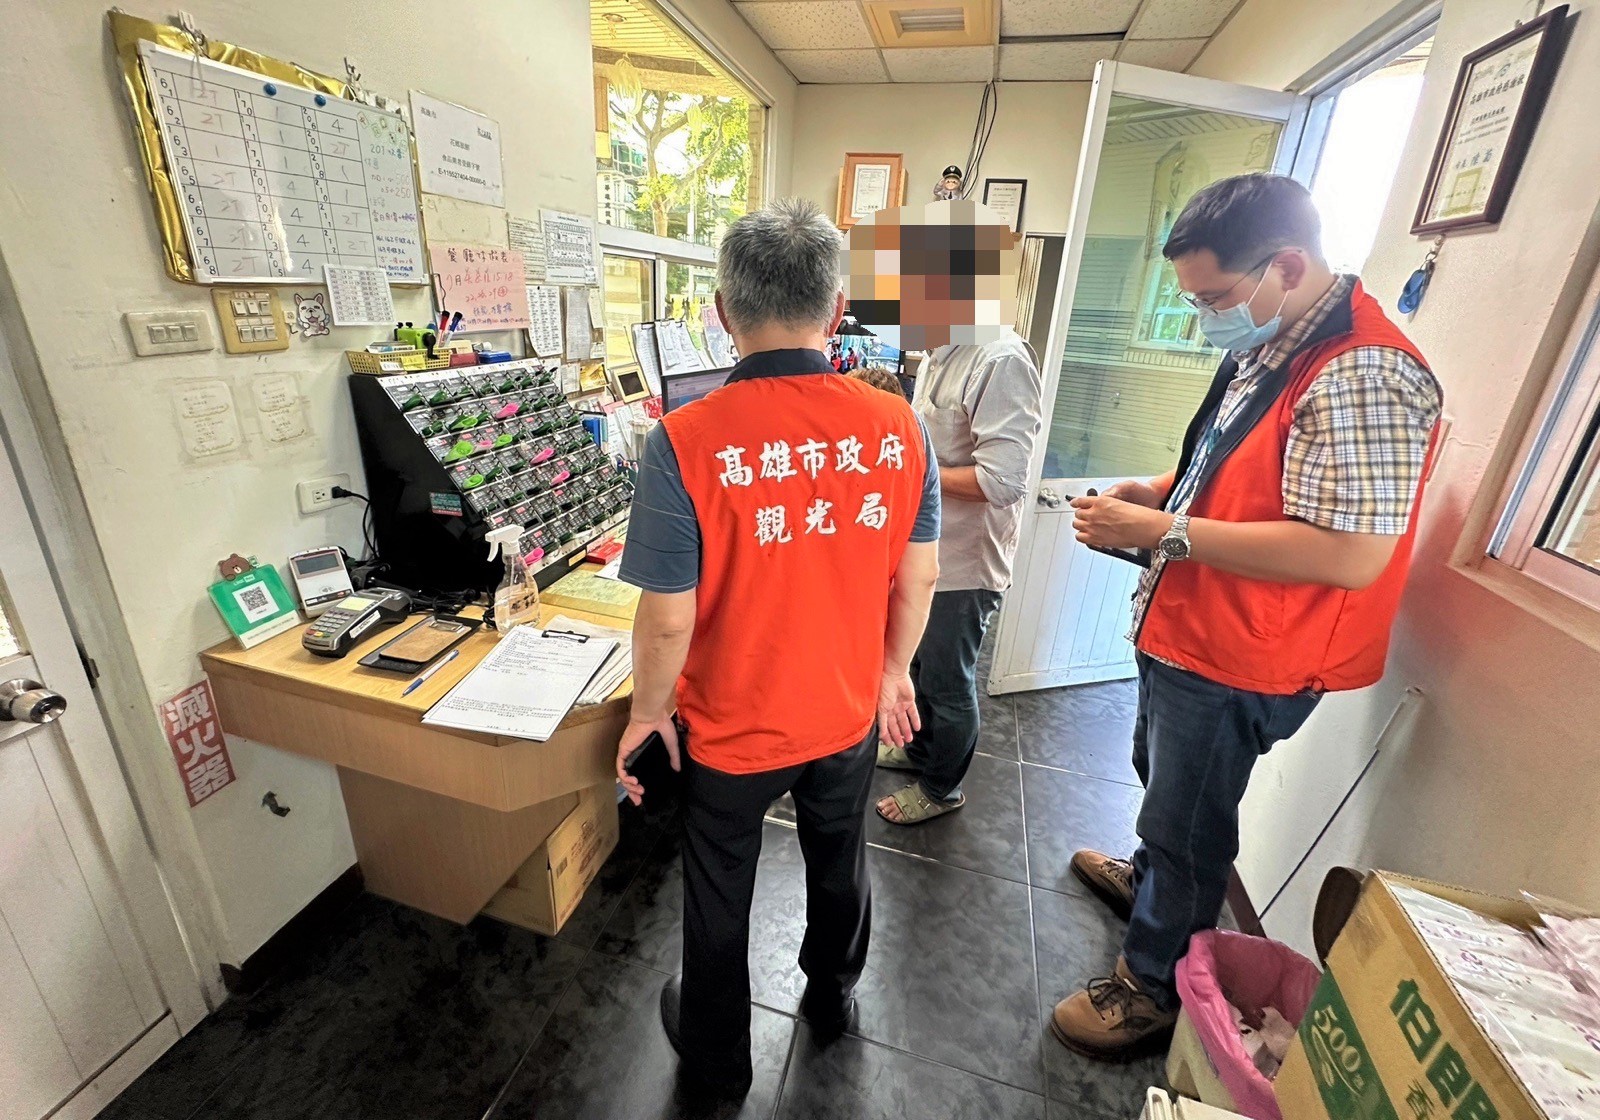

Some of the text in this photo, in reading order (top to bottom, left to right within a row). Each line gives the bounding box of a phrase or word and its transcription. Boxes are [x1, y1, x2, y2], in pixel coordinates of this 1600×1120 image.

[331, 118, 344, 133] 4
[290, 207, 304, 223] 4
[296, 233, 310, 248] 4
[301, 258, 315, 275] 4
[715, 433, 905, 488] 高雄市政府
[754, 492, 888, 546] 觀光局
[164, 686, 231, 803] 滅火器
